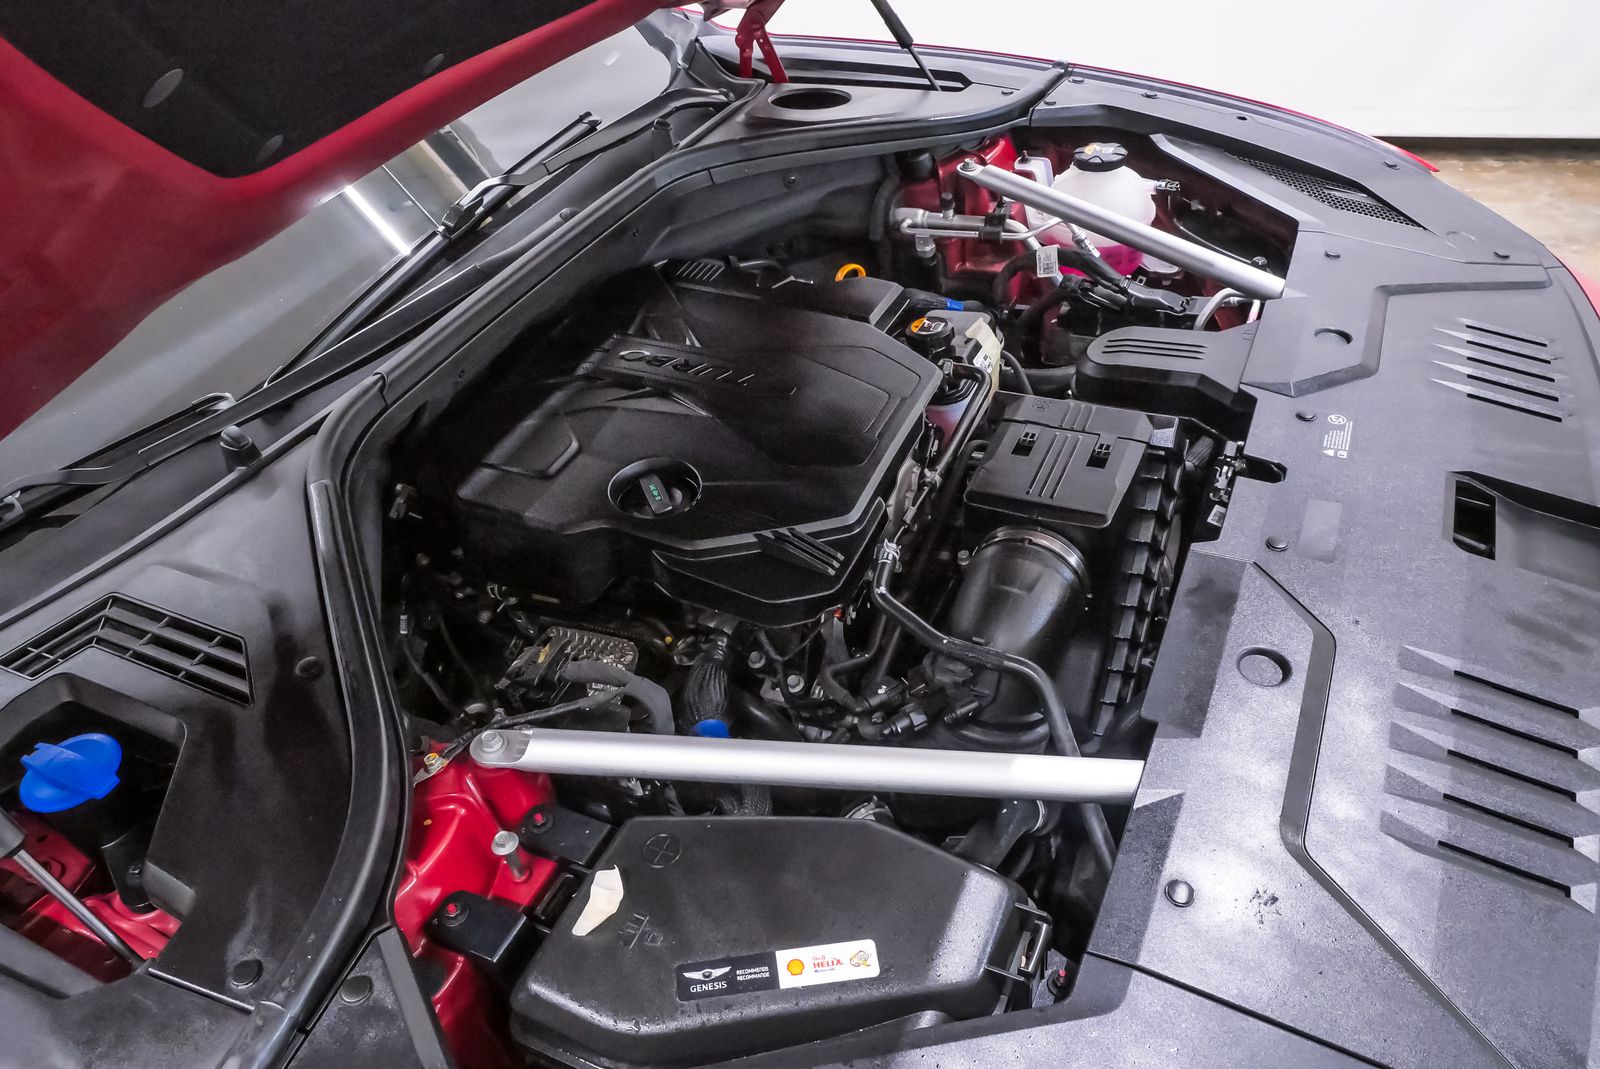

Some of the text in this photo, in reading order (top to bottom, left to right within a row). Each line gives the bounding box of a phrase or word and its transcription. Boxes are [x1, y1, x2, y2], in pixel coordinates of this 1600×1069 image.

[813, 959, 843, 969] HELIX
[736, 966, 769, 975] RECOMMENDS
[737, 972, 770, 981] RECOMMANDE
[690, 981, 727, 993] GENESIS
